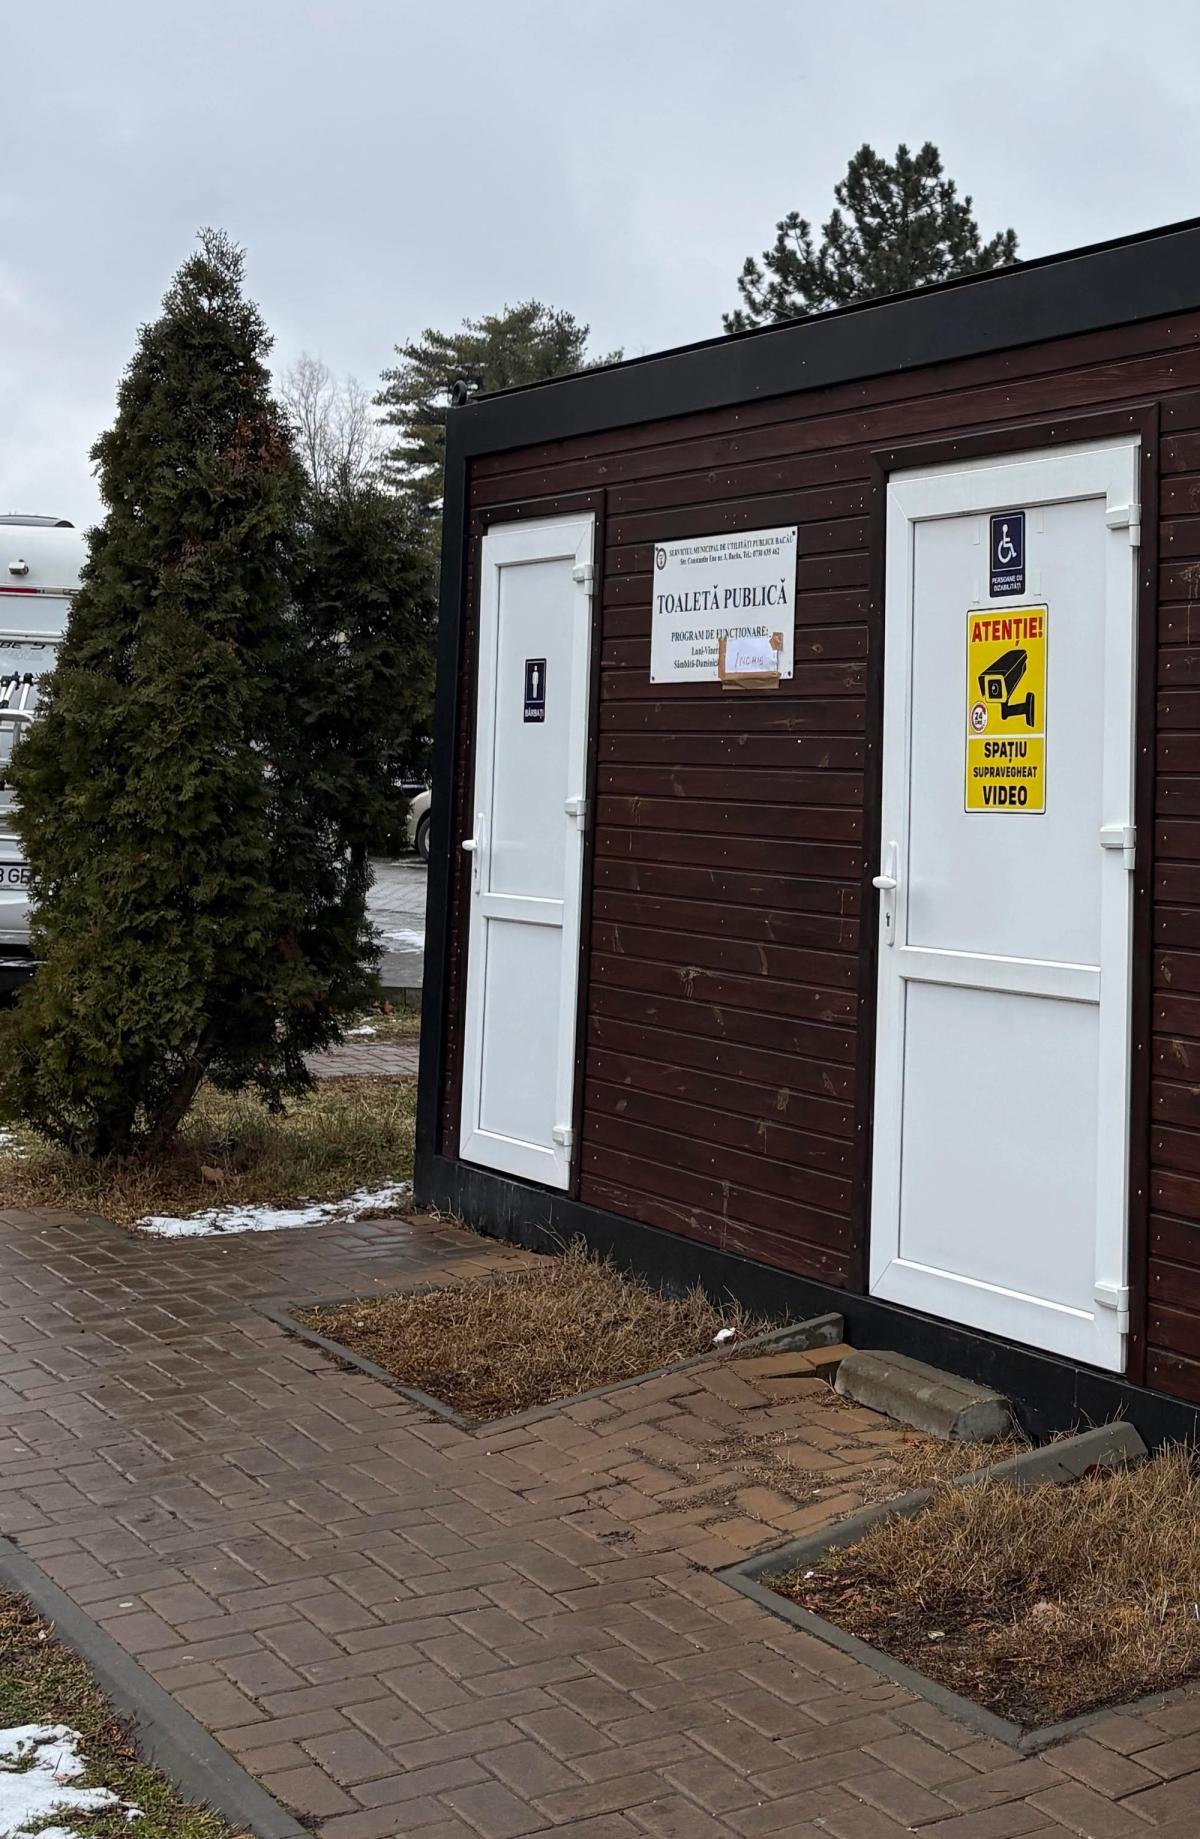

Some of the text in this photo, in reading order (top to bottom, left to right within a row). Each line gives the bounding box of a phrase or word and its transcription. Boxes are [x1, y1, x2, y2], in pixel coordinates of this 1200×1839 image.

[719, 543, 726, 551] DE
[1016, 574, 1023, 582] CU
[657, 578, 788, 614] TOALETĂ PUBLICĂ
[671, 630, 706, 642] PROGRAM
[706, 629, 714, 640] DE
[974, 711, 983, 720] 24
[984, 741, 1027, 763] SPAȚIU
[973, 766, 1038, 778] SUPRAVEGHEAT
[983, 785, 1028, 806] VIDEO
